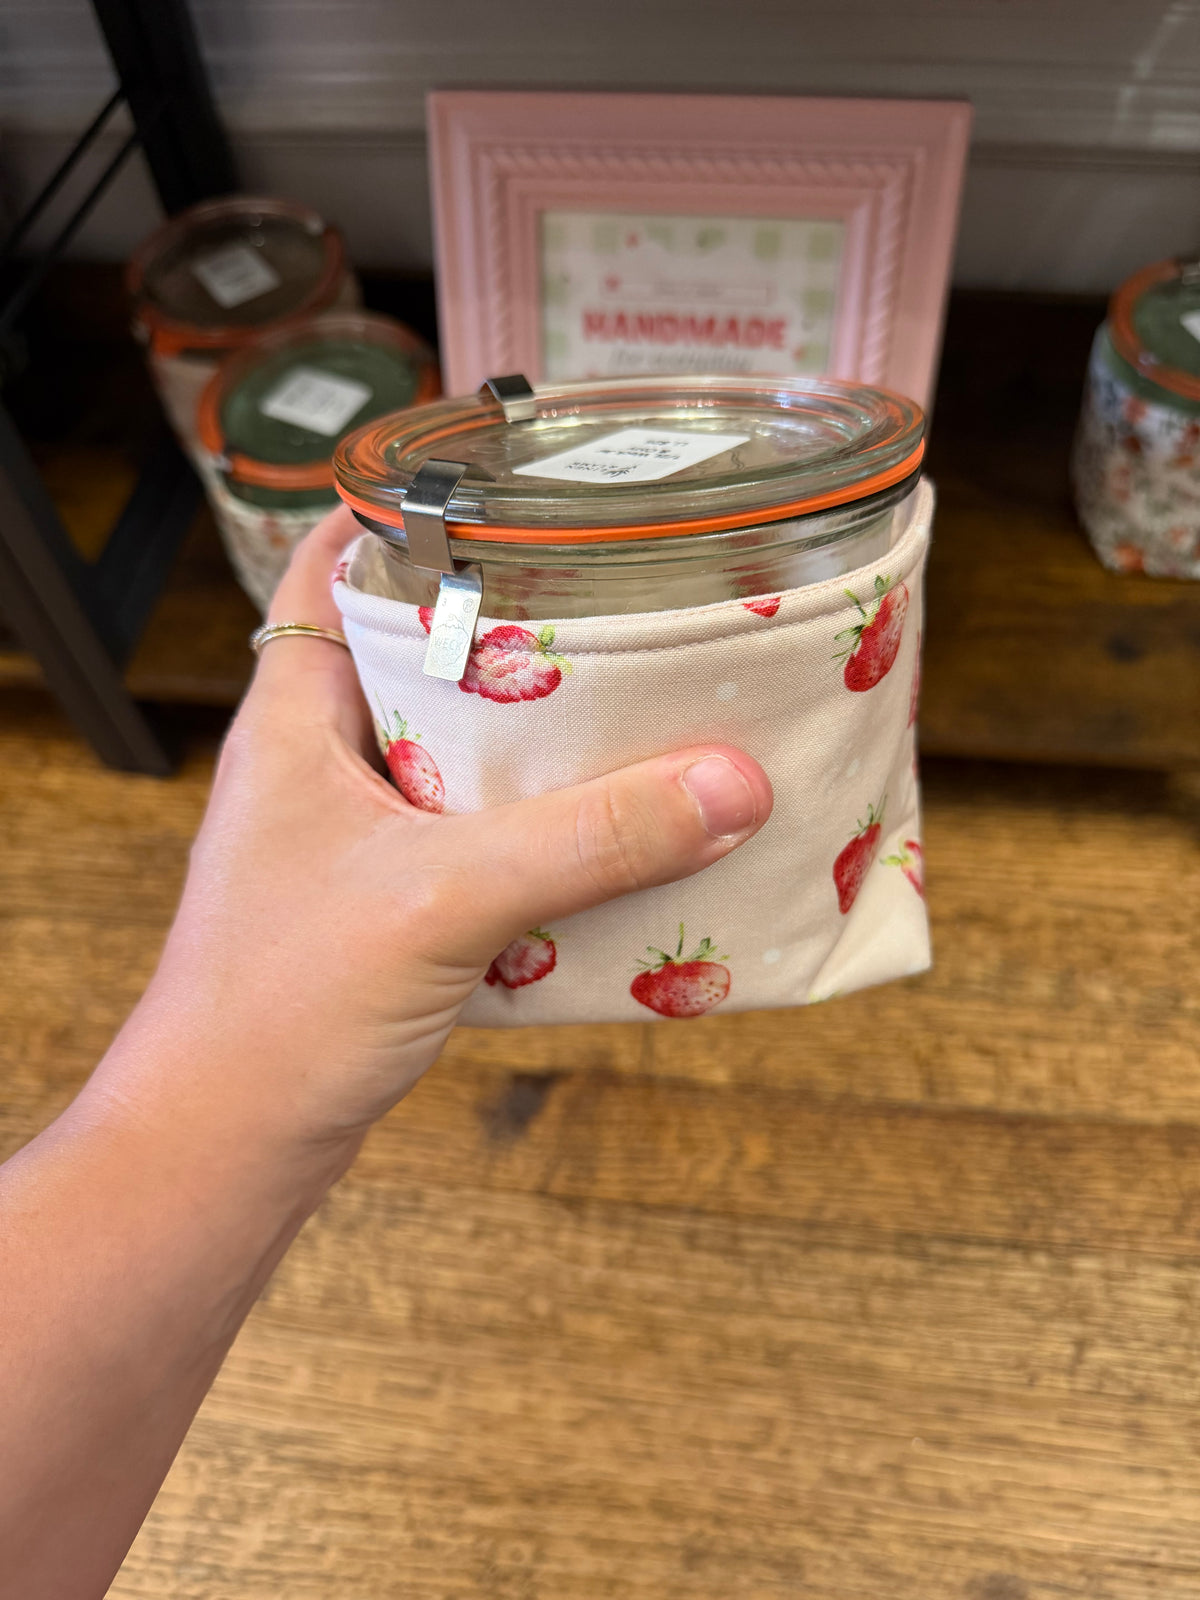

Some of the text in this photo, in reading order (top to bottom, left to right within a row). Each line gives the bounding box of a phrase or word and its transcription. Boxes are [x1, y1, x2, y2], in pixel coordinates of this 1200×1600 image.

[583, 309, 788, 350] HANDMADE
[566, 463, 608, 473] LINEN
[573, 460, 606, 468] LAMB
